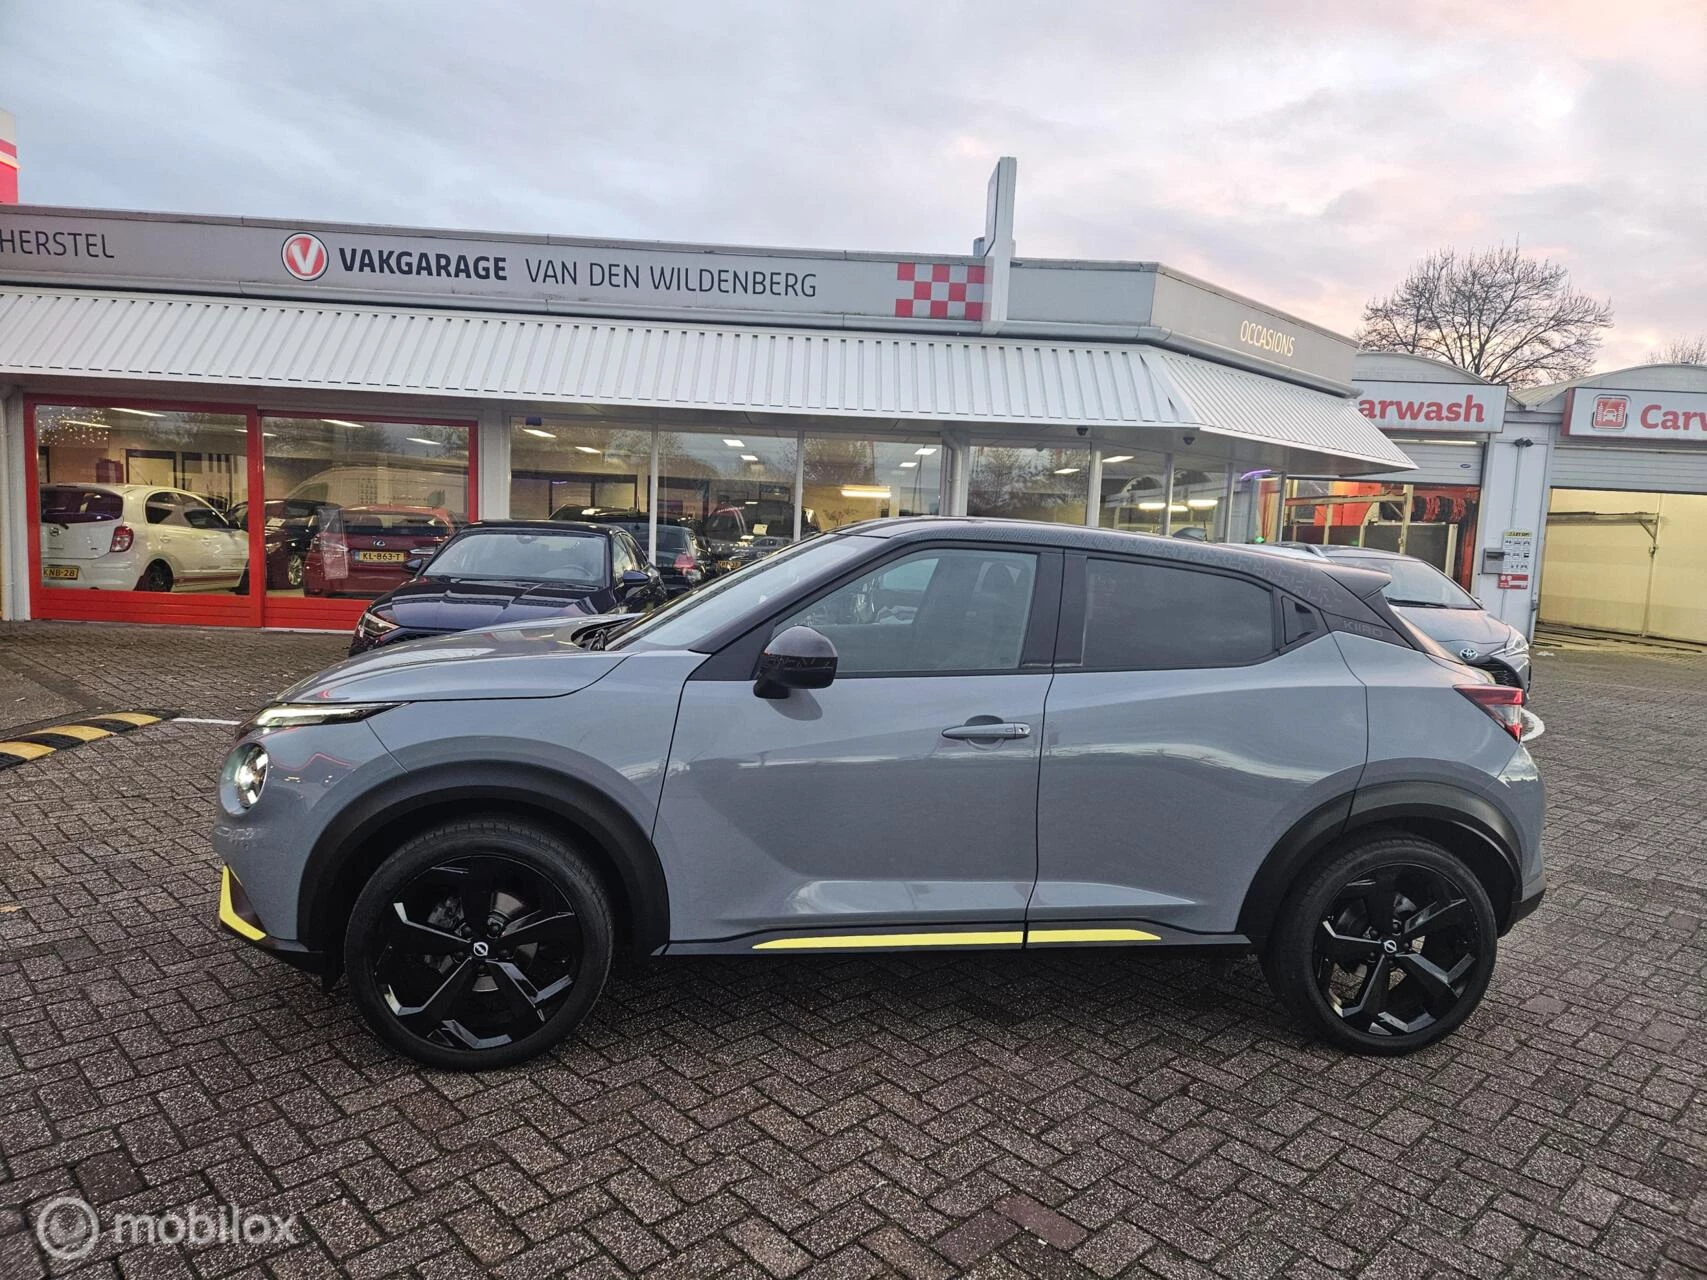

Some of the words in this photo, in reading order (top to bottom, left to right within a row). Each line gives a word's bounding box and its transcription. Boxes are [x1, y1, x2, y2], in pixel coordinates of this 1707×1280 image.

[0, 229, 115, 258] HERSTEL
[339, 247, 508, 281] VAKGARAGE
[525, 258, 577, 285] VAN
[589, 262, 640, 289] DEN
[650, 265, 817, 298] WILDENBERG
[1240, 320, 1296, 357] OCCASIONS
[362, 553, 401, 561] KL-863-T
[1343, 620, 1384, 637] KIIRO
